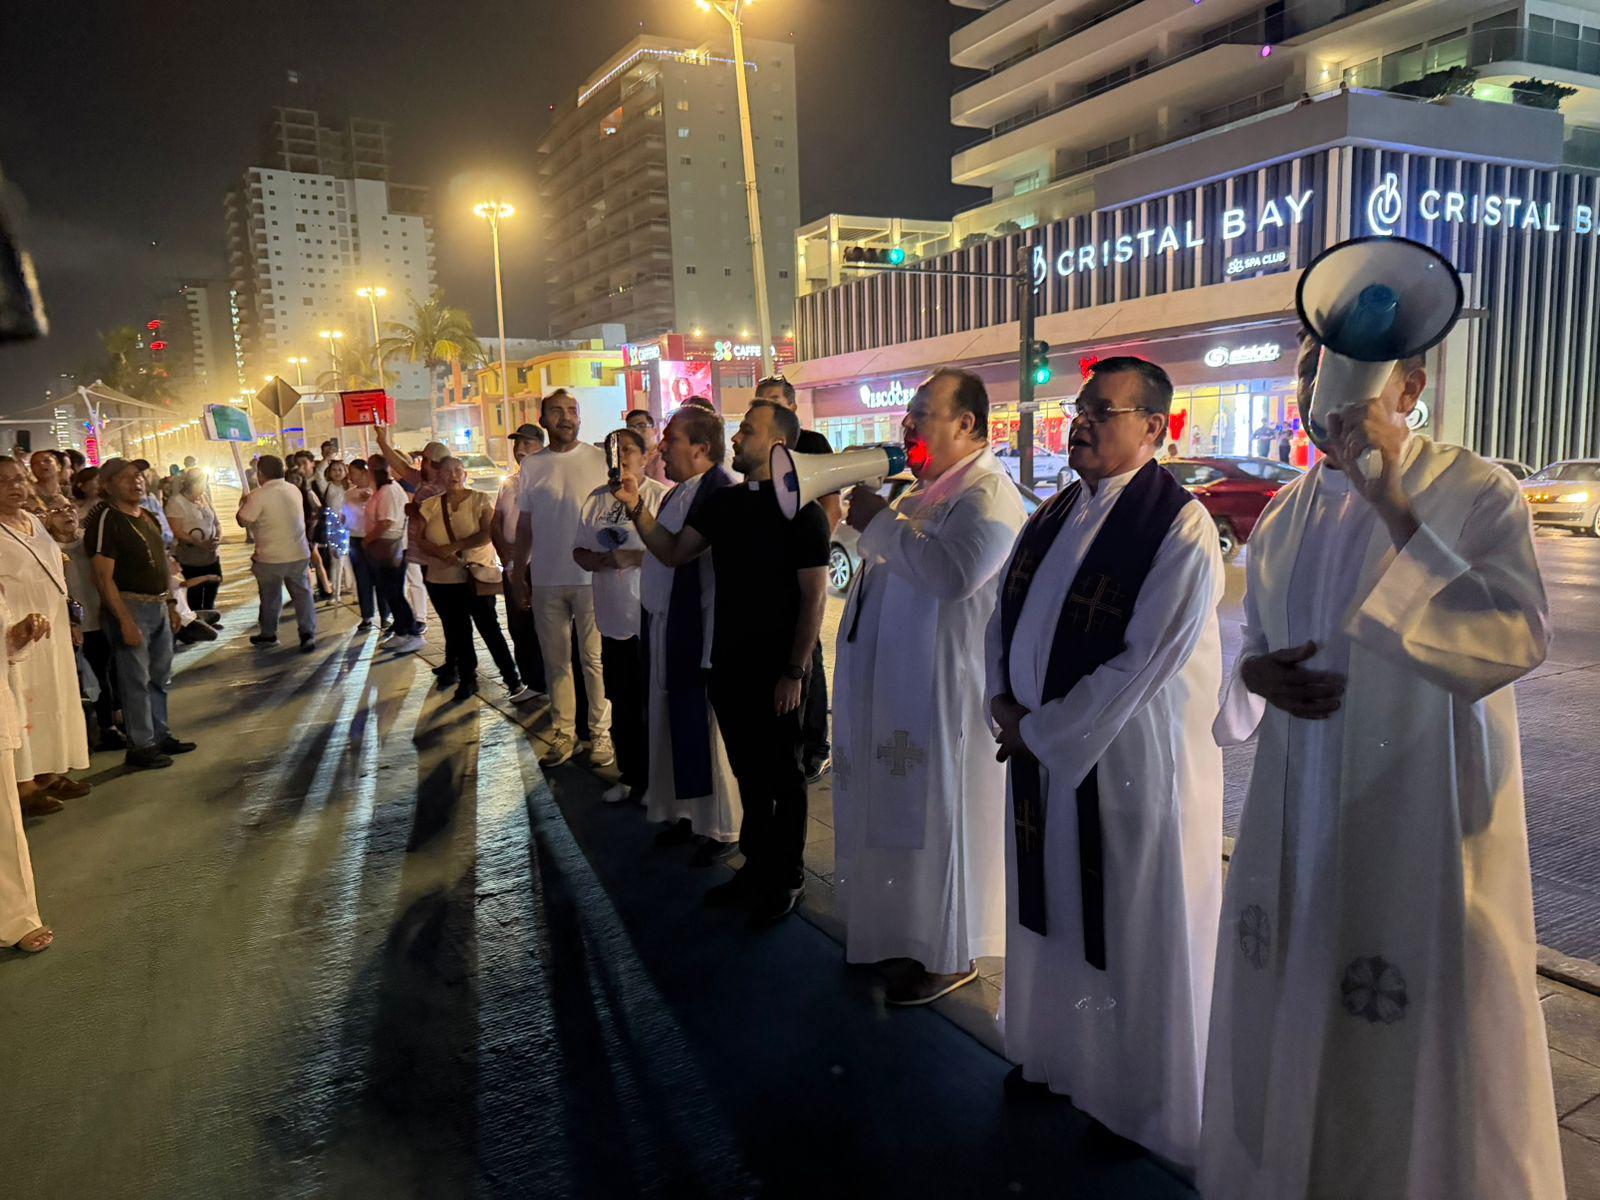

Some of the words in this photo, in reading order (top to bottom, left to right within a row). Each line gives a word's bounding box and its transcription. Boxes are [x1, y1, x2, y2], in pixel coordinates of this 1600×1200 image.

[1057, 219, 1204, 277] CRISTAL
[1222, 189, 1314, 241] BAY
[1419, 189, 1560, 232] CRISTAL
[1575, 204, 1600, 235] B
[1244, 256, 1261, 268] SPA
[1262, 251, 1286, 265] CLUB
